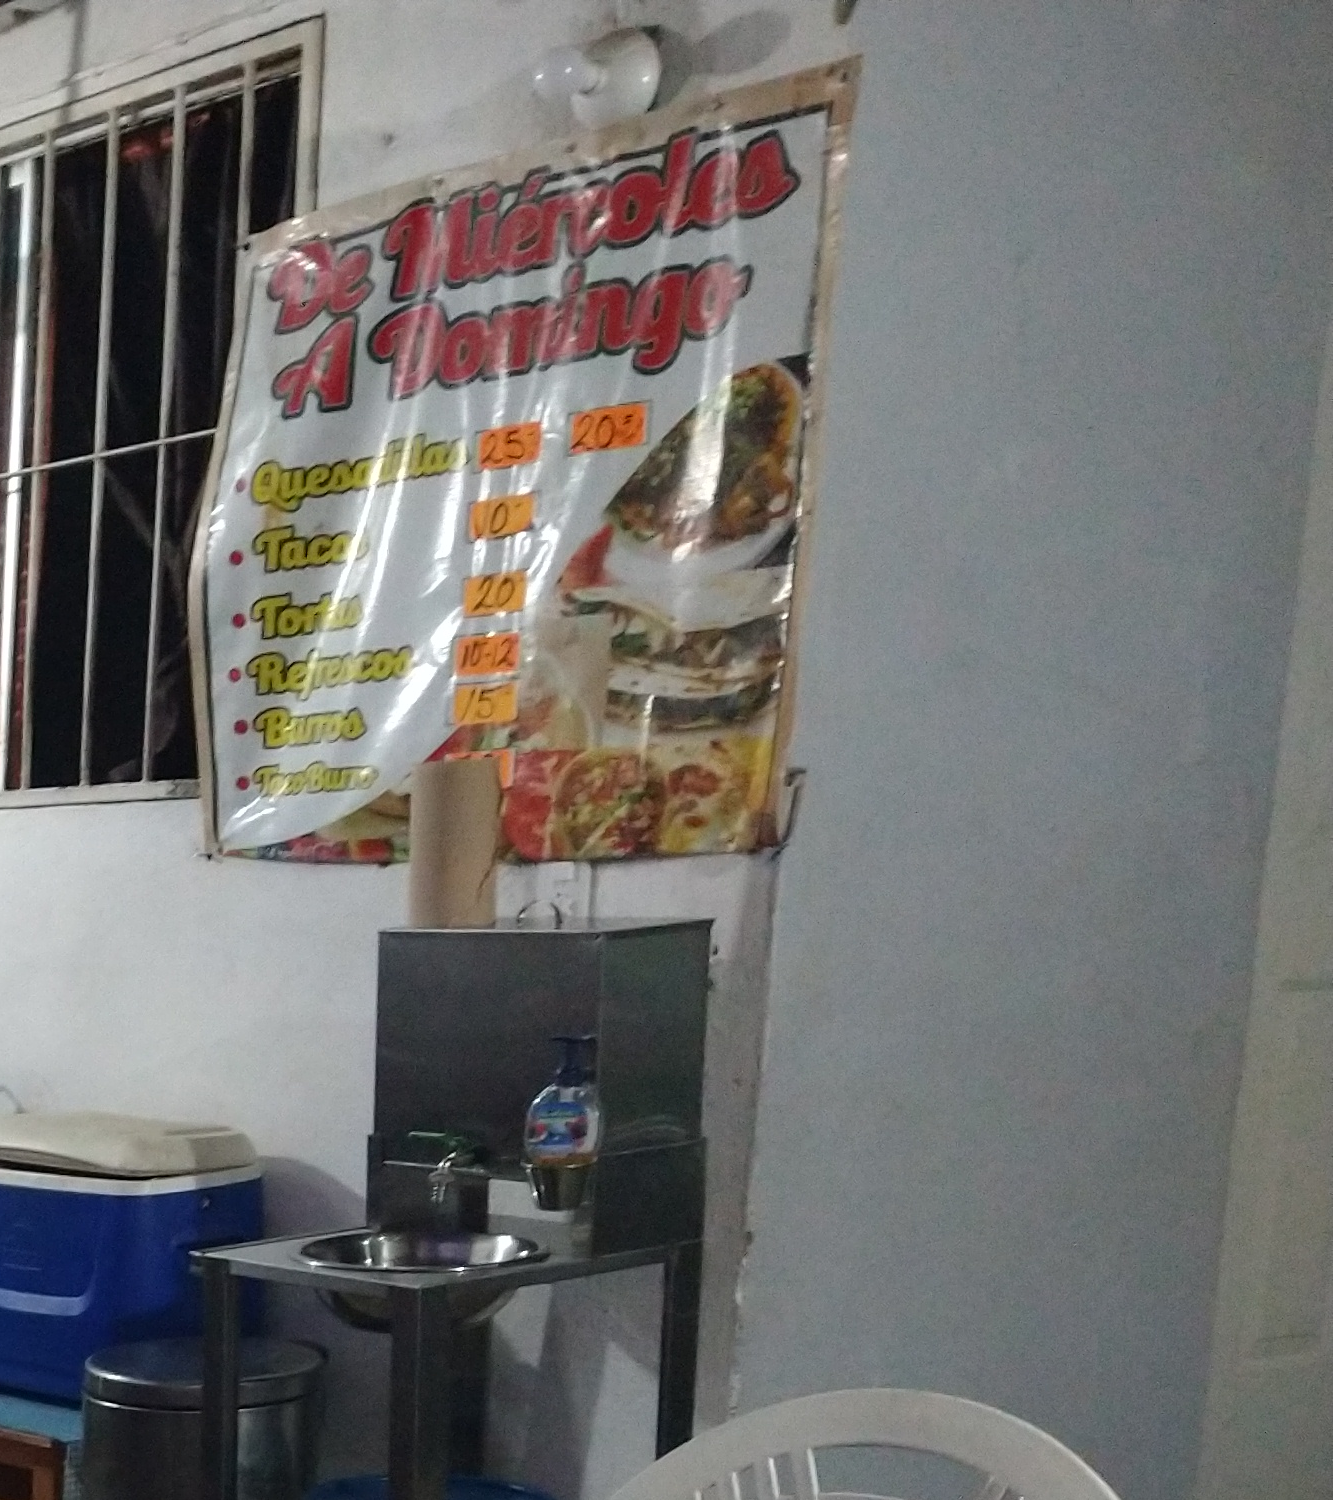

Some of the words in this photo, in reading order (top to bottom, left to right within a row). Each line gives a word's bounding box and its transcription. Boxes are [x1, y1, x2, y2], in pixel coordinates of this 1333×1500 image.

[268, 241, 375, 334] De
[383, 126, 800, 299] Miércoles
[273, 313, 359, 418] A
[368, 254, 754, 401] Domingo
[253, 706, 367, 750] Burros
